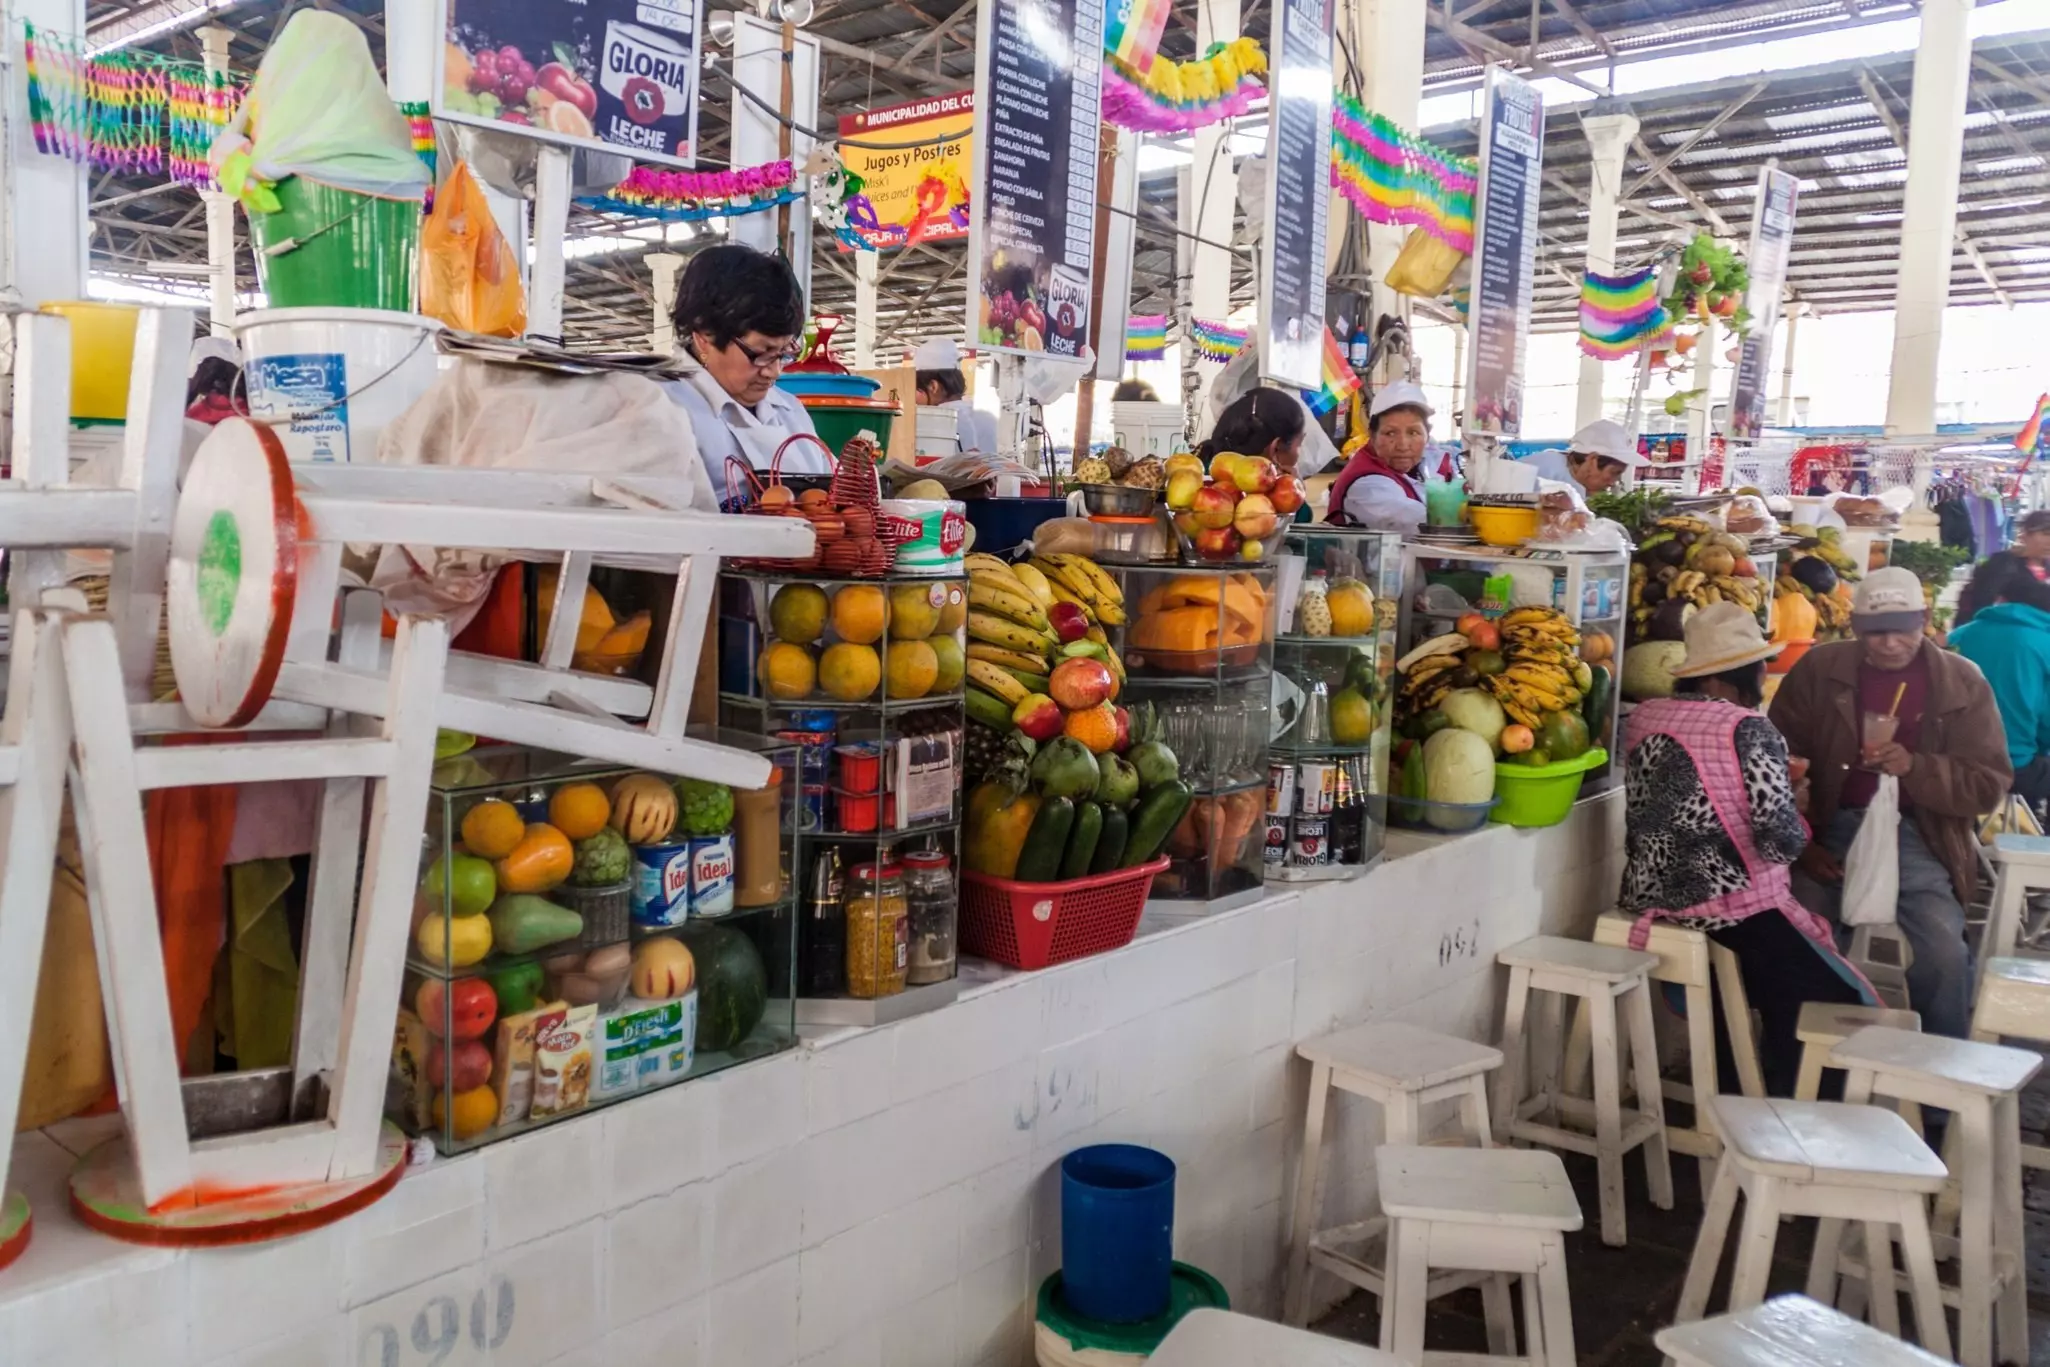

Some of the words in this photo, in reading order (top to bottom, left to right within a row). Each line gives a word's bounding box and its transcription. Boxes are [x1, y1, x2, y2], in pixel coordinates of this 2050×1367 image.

[609, 41, 685, 94] GLORIA
[1018, 72, 1030, 85] CON
[1030, 77, 1046, 91] LECHE
[1020, 88, 1032, 99] CON
[867, 101, 940, 127] MUNICIPALIDAD
[941, 98, 960, 113] DEL
[1020, 102, 1032, 114] CON
[610, 115, 667, 149] LECHE
[995, 122, 1023, 139] EXTRACTO
[1023, 131, 1031, 141] DE
[994, 136, 1023, 152] ENSALADA
[1023, 145, 1031, 155] DE
[864, 153, 900, 172] Jugos
[903, 152, 911, 168] y
[914, 143, 961, 163] Postres
[994, 150, 1026, 167] ZANAHORIA
[993, 164, 1020, 179] NARANJA
[867, 191, 890, 203] uices
[1013, 184, 1025, 195] CON
[1051, 278, 1085, 313] GLORIA
[1051, 332, 1076, 354] LECHE
[262, 363, 324, 389] Mesa
[944, 517, 965, 544] Elite
[668, 868, 688, 891] Ide
[696, 857, 731, 882] Ideal
